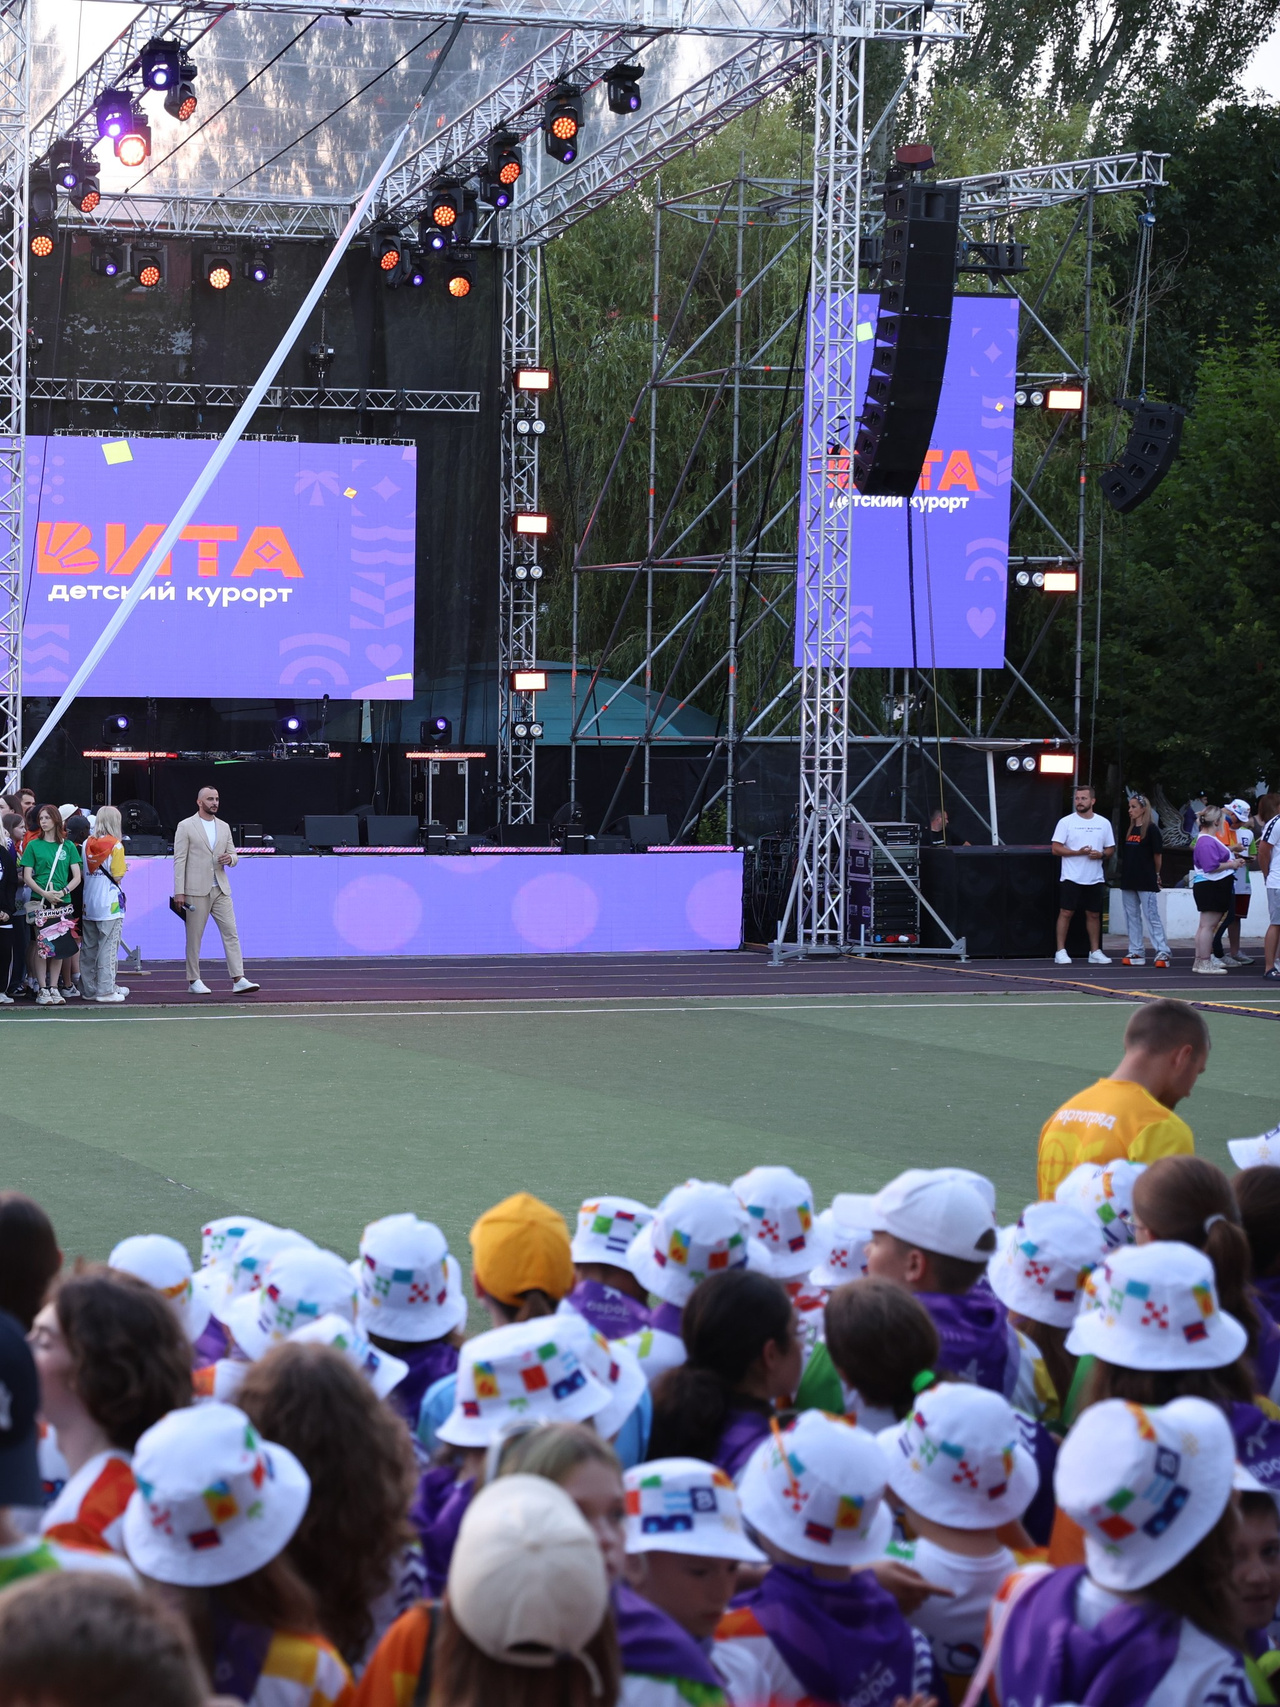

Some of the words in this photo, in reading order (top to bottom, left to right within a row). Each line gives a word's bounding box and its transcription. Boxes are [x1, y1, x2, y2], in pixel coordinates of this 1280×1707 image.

[909, 496, 970, 513] курорт
[36, 521, 305, 578] ВИТА
[187, 586, 294, 608] курорт
